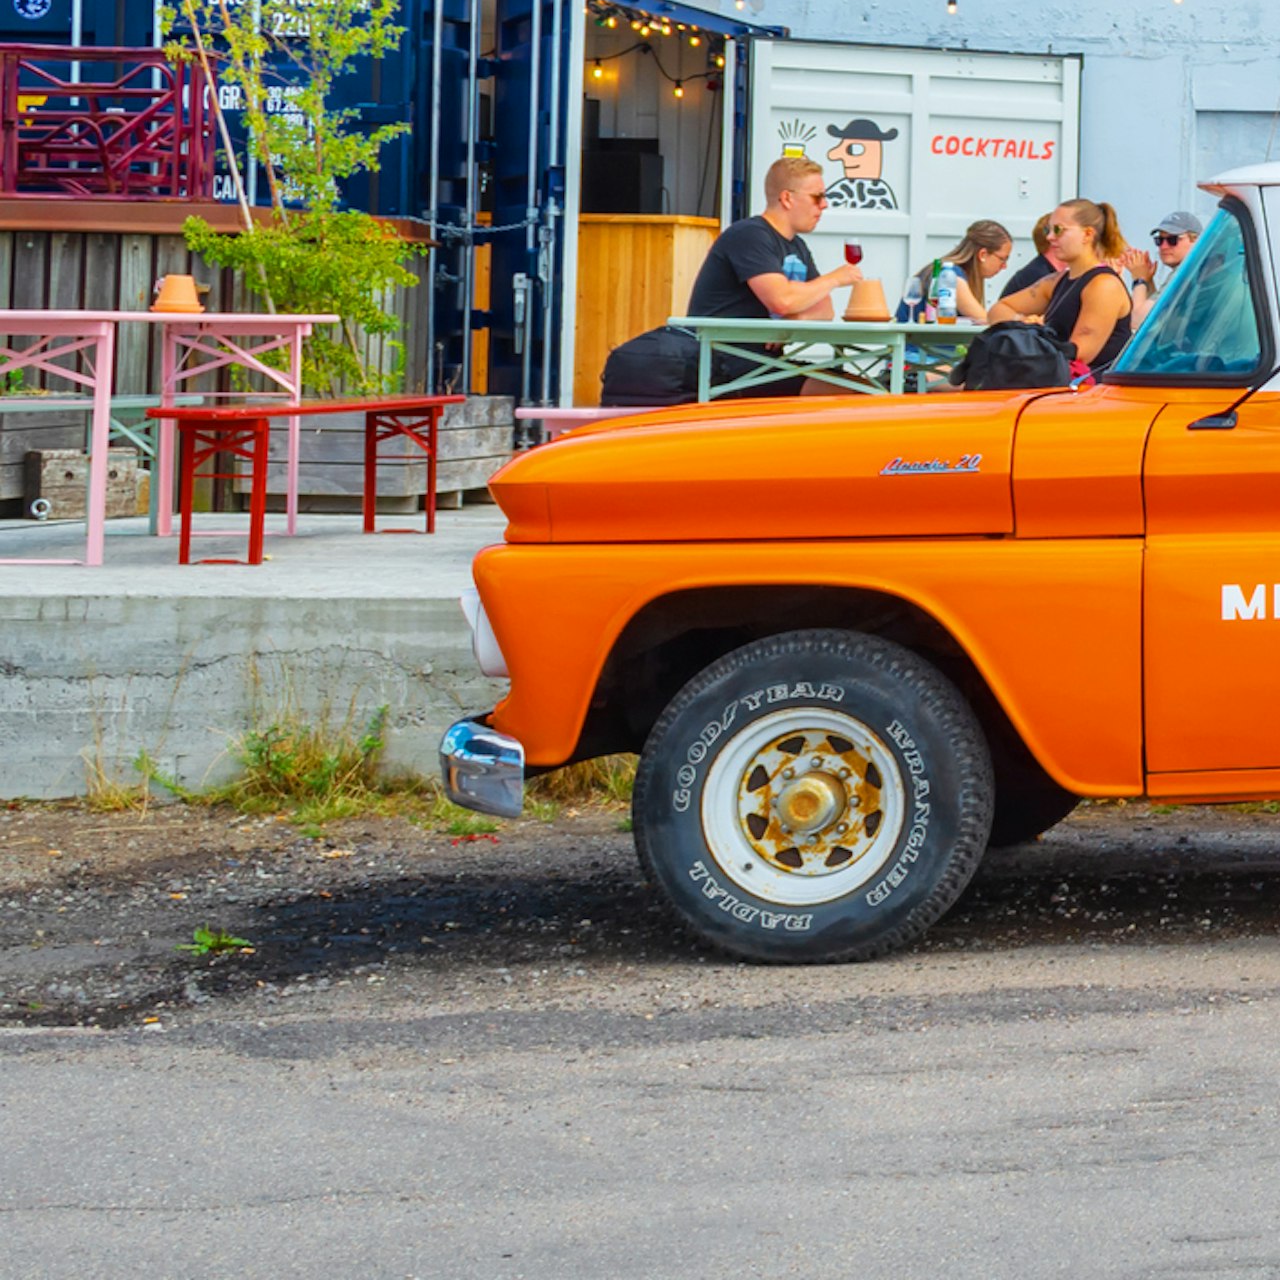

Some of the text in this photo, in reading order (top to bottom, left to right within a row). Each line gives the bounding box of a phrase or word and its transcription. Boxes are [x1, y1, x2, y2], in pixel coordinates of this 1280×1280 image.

[931, 135, 1056, 160] COCKTAILS
[866, 720, 930, 906] WRANGLER
[689, 861, 813, 931] RADIAL
